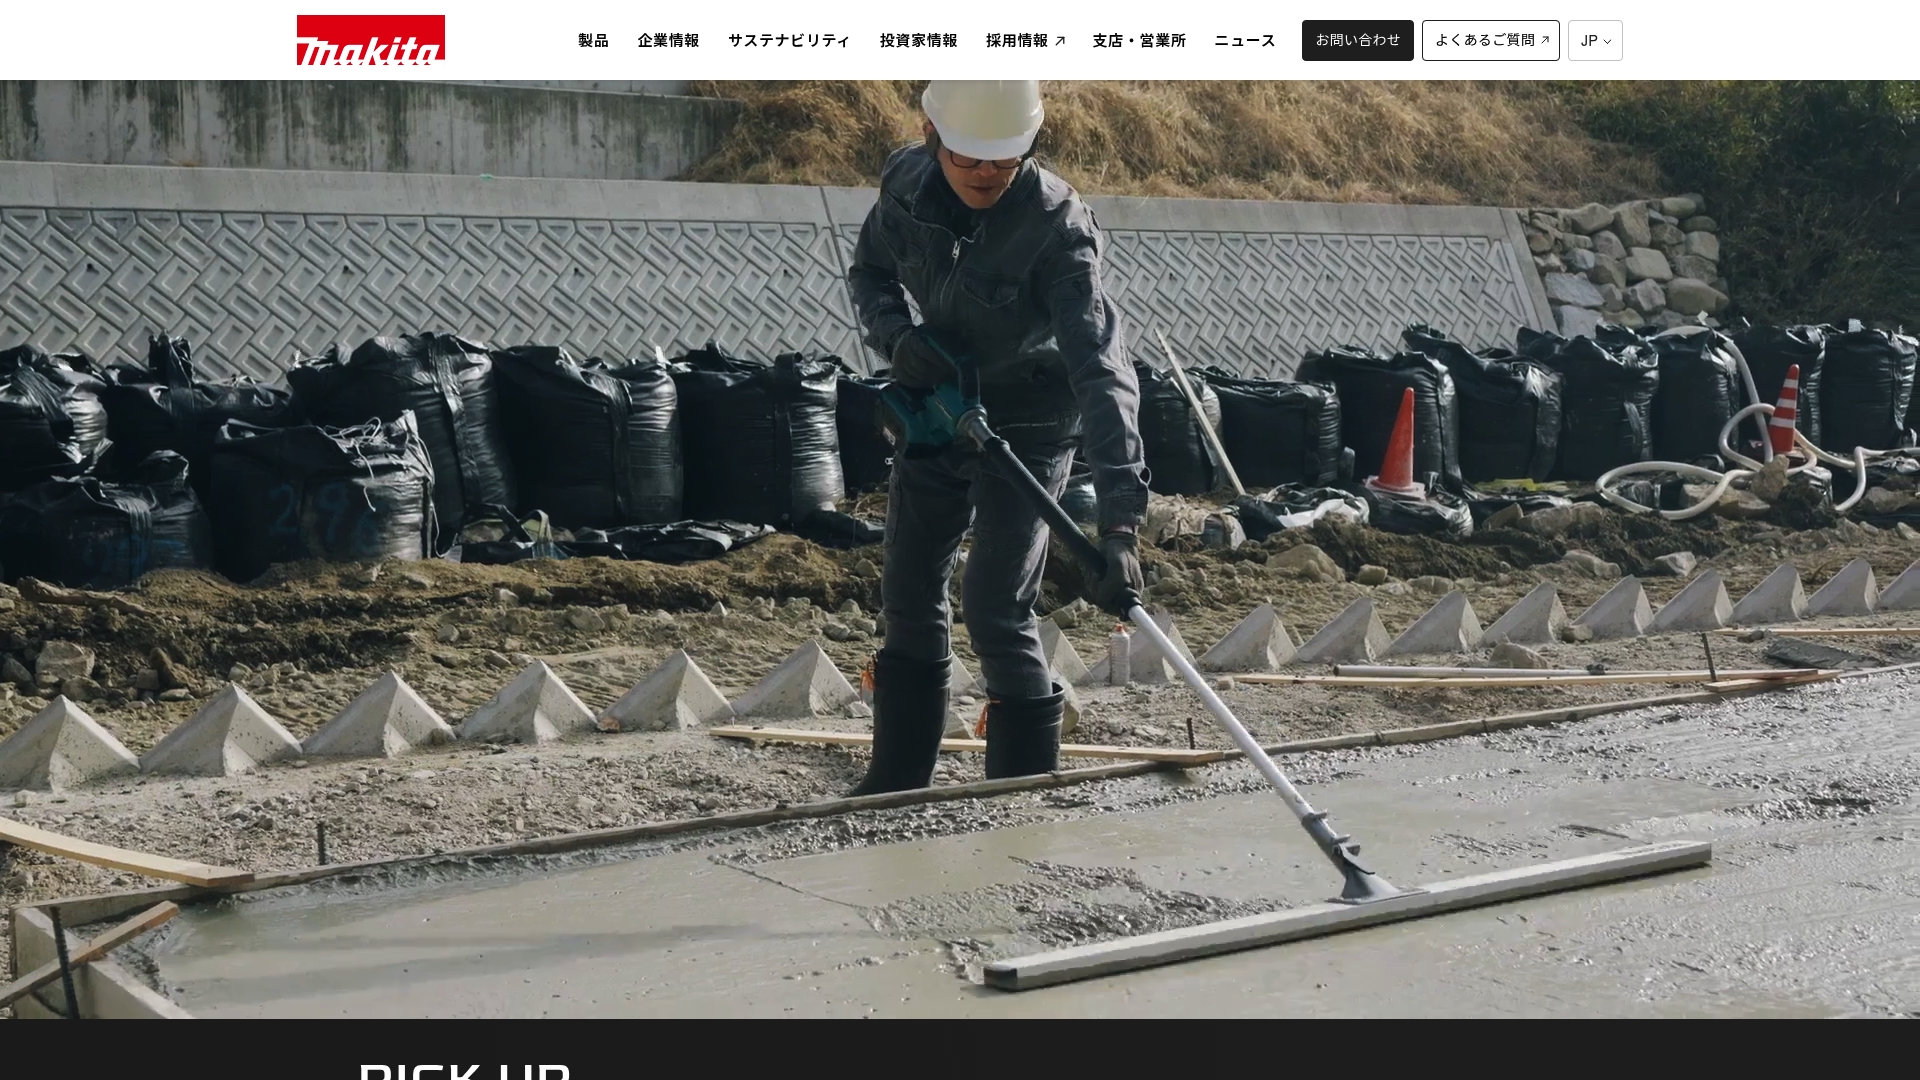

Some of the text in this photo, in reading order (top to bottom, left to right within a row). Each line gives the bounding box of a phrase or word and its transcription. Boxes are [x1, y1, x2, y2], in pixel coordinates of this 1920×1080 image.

[578, 32, 609, 48] 製品
[638, 32, 700, 48] 企業情報
[729, 32, 849, 48] サステナビリティ
[880, 32, 958, 48] 投資家情報
[986, 32, 1048, 48] 採用情報
[1093, 32, 1187, 48] 支店・営業所
[1215, 34, 1275, 48] ニュース
[1316, 32, 1400, 47] お問い合わせ
[1435, 32, 1535, 47] よくあるご質問
[1580, 34, 1598, 47] JP
